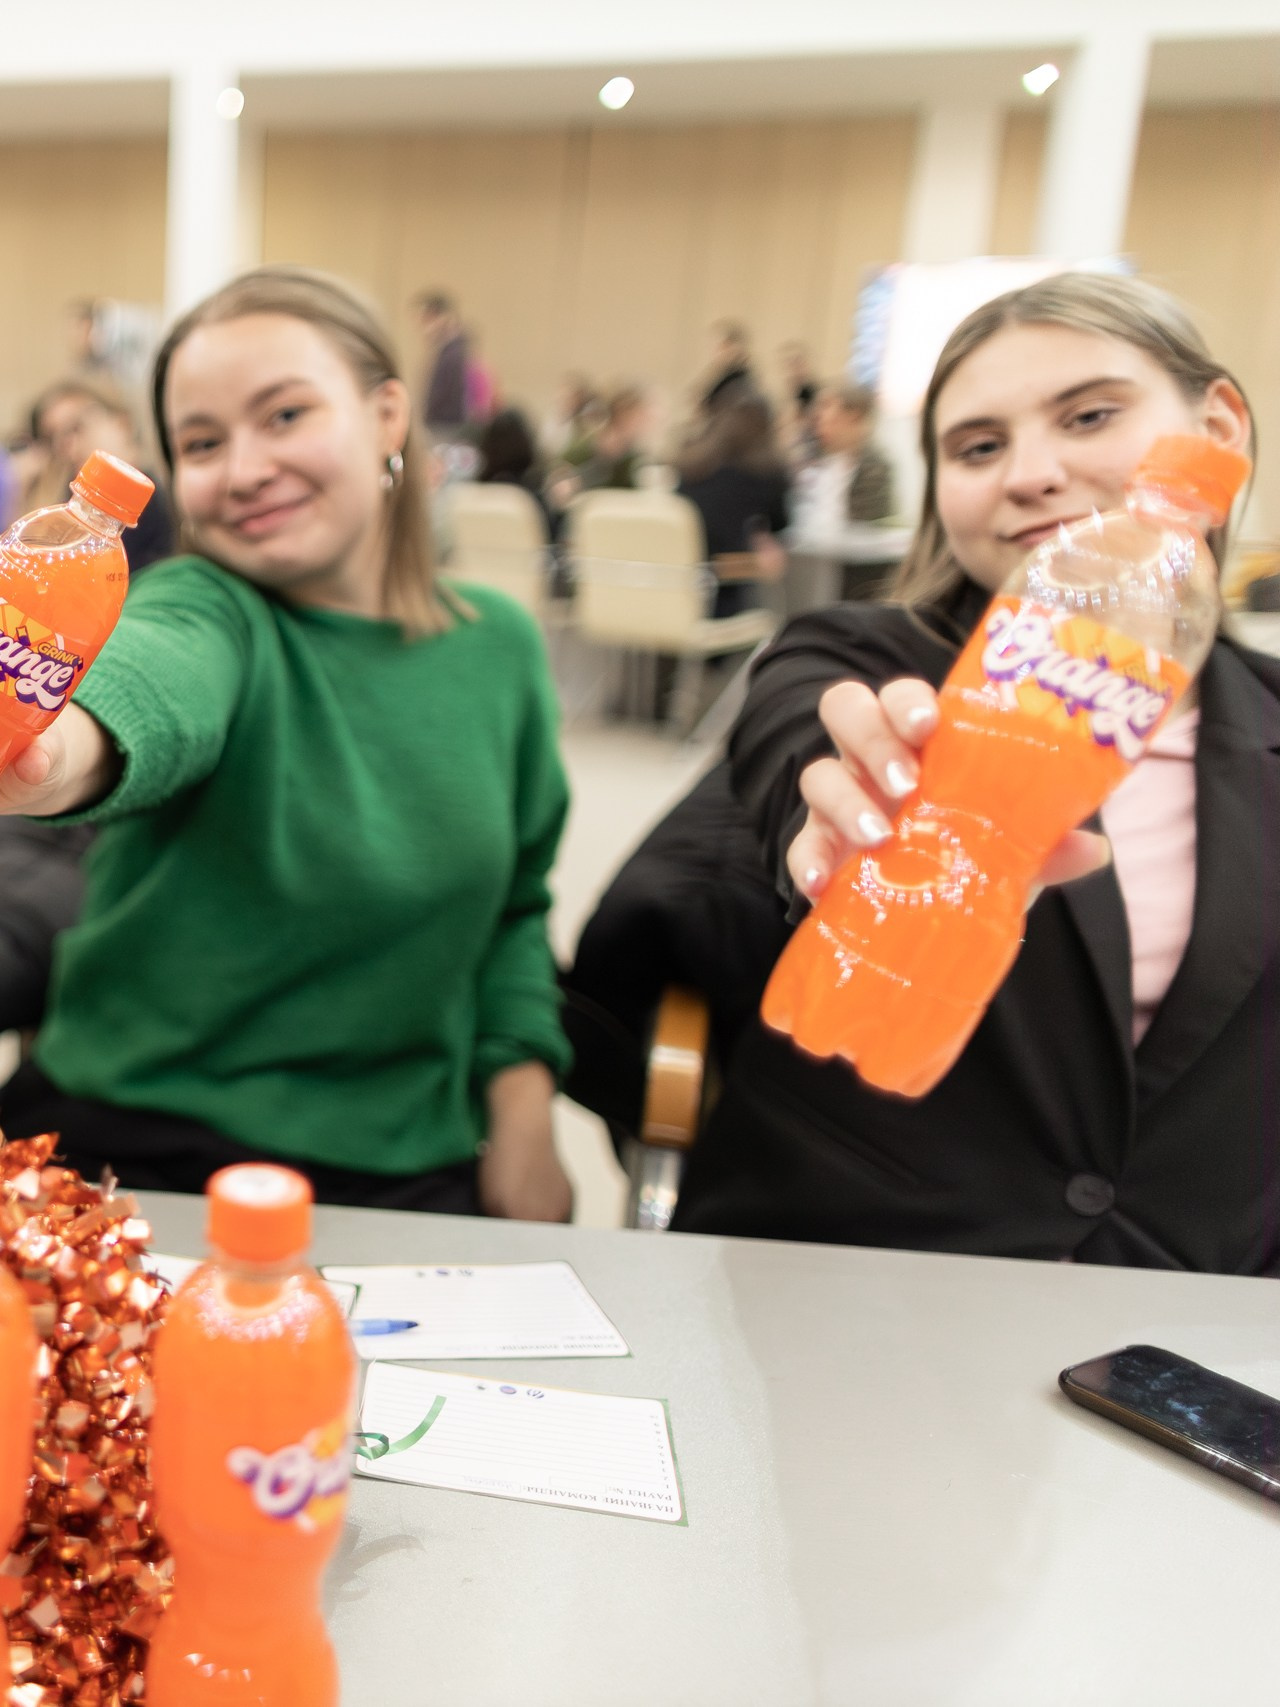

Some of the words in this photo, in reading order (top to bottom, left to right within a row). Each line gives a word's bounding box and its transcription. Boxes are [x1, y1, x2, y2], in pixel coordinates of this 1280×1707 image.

[37, 642, 77, 666] GRINK
[982, 608, 1168, 760] Orange
[601, 1497, 674, 1514] НАЗВАНИЕ
